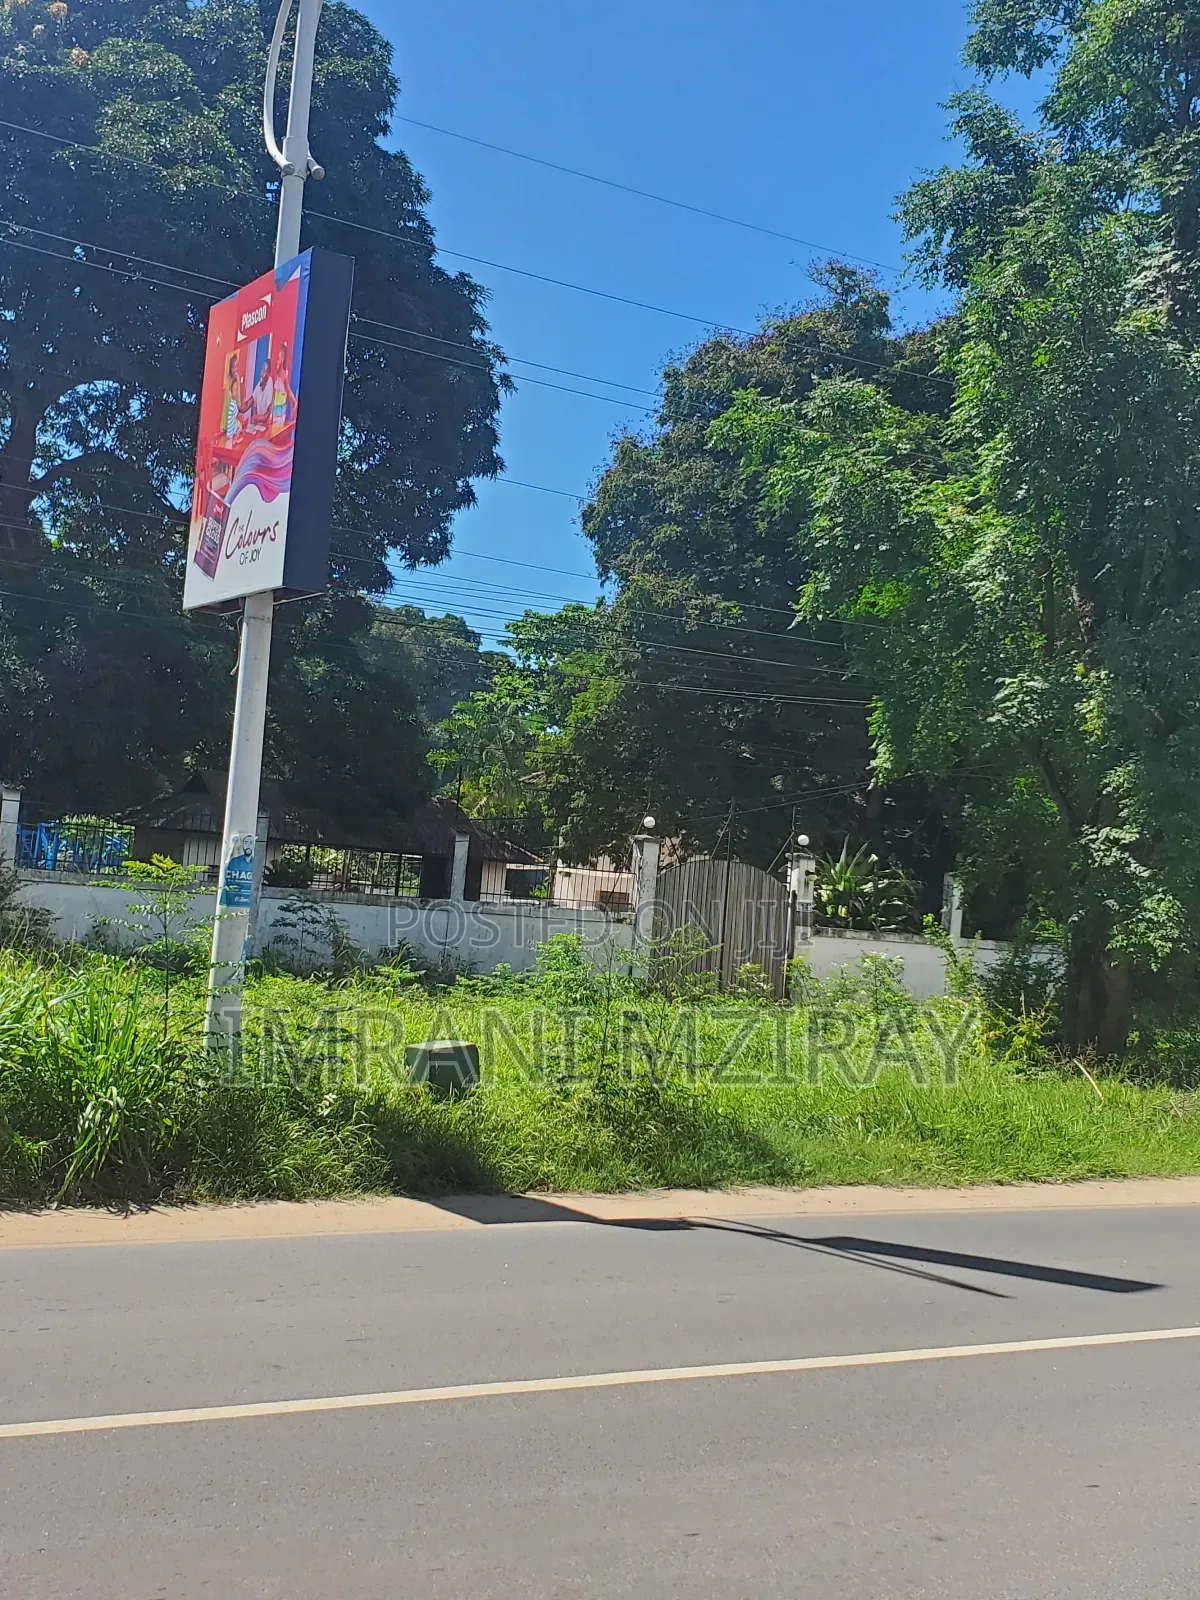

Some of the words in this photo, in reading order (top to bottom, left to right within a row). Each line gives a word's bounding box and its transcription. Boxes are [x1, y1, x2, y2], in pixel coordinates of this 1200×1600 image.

[241, 304, 267, 332] Plascon
[225, 509, 279, 559] Colours
[239, 550, 249, 566] OF
[249, 547, 262, 563] JOY
